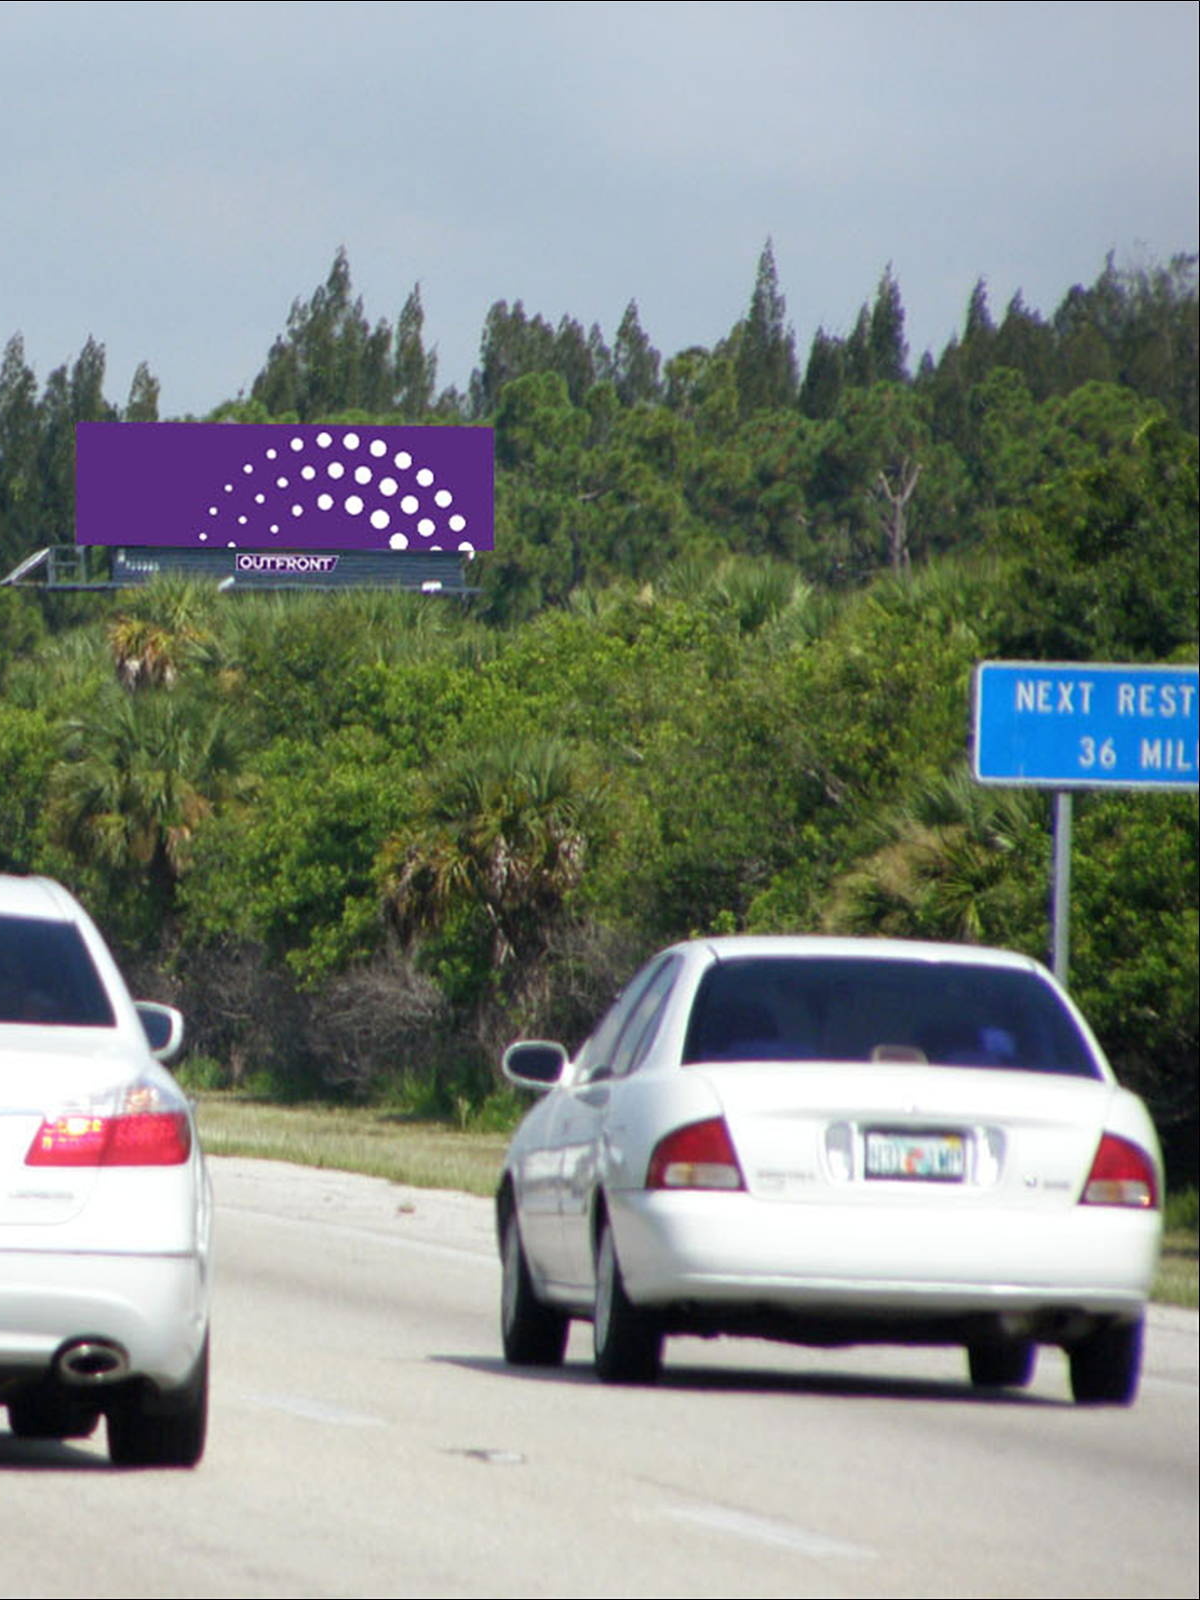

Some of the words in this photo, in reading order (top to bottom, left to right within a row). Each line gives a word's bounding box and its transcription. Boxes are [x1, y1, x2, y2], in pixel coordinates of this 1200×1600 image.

[239, 555, 333, 570] OUTFRONT
[1016, 681, 1094, 714] NEXT
[1118, 683, 1195, 718] REST
[1079, 737, 1116, 769] 36
[1141, 739, 1199, 771] MIL
